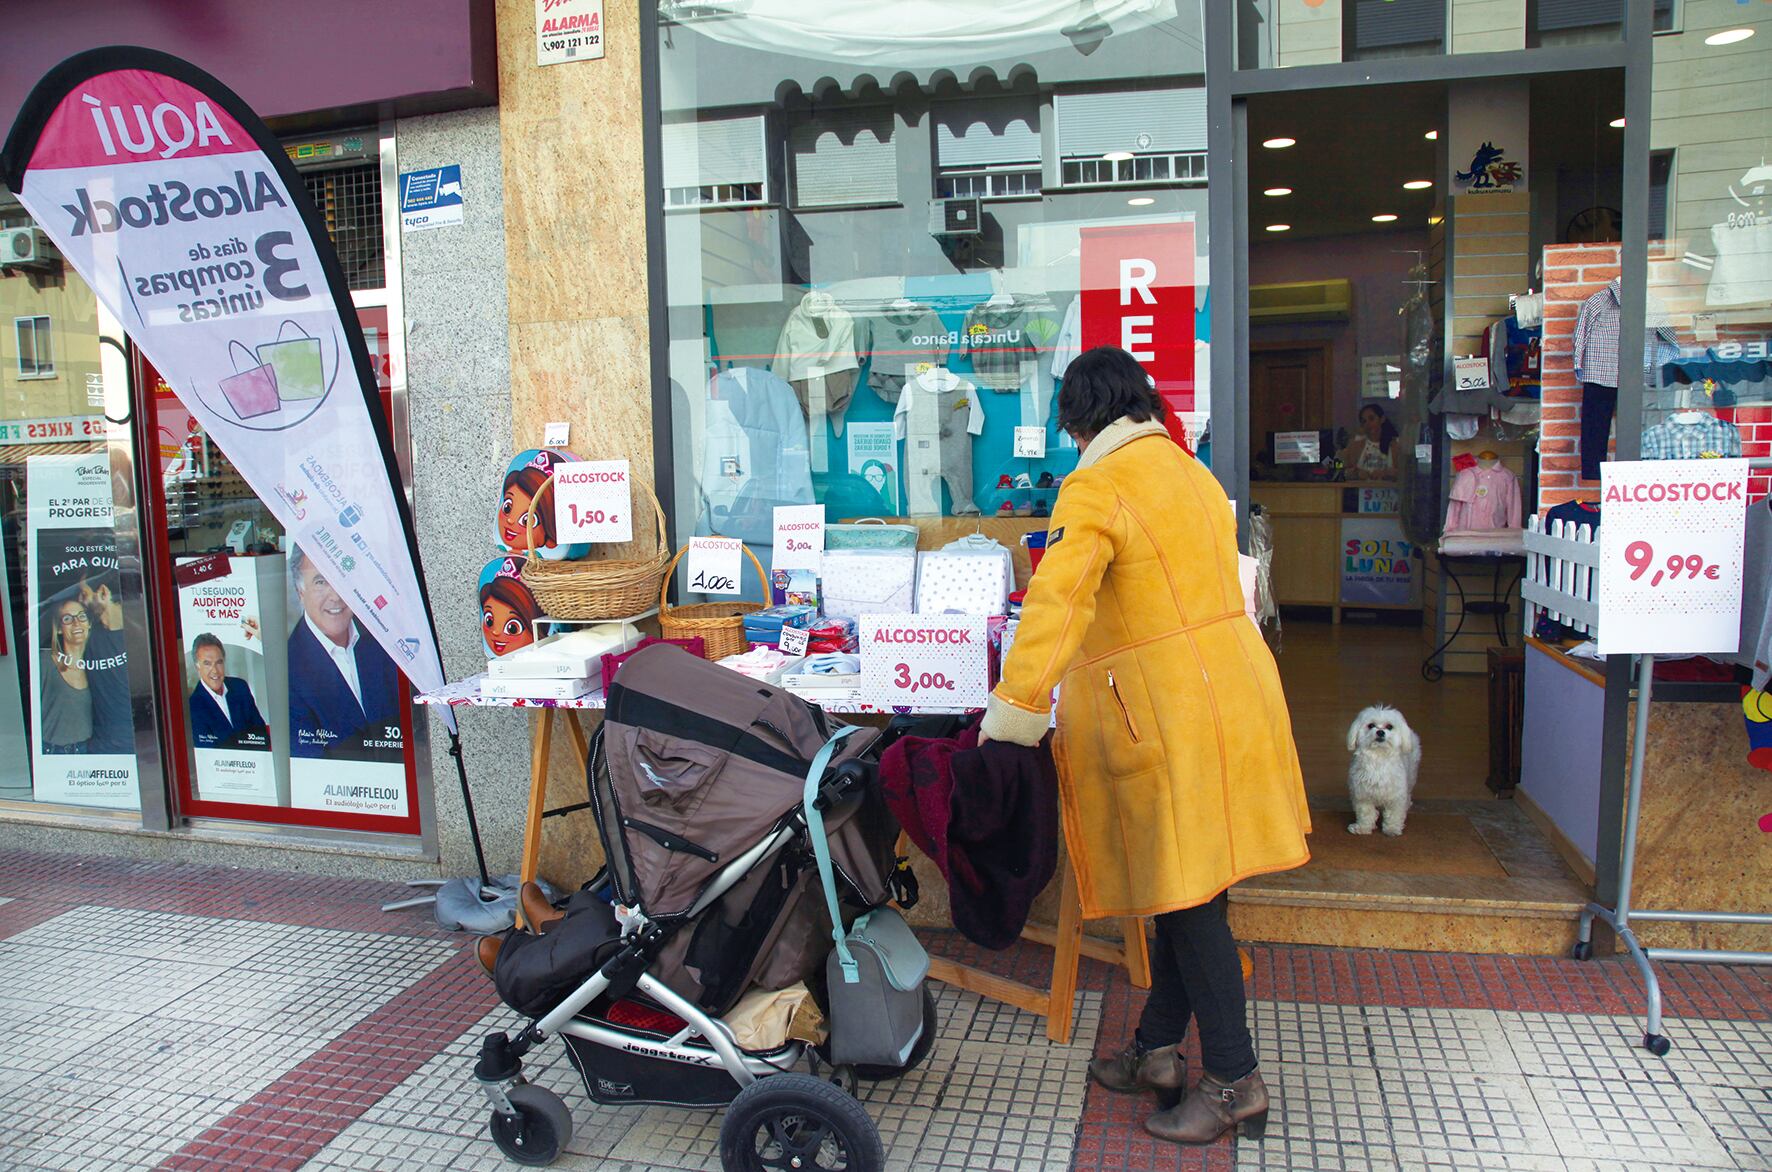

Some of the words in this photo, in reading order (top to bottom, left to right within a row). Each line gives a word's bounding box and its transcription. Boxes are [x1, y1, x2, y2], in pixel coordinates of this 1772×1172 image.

[541, 12, 599, 33] ALARMA
[550, 40, 565, 50] 902
[567, 37, 581, 48] 121
[584, 35, 600, 45] 122
[405, 216, 429, 227] tyco
[558, 472, 625, 484] ALCOSTOCK
[1605, 482, 1742, 503] ALCOSTOCK
[73, 498, 90, 506] PAR
[49, 507, 114, 518] PROGRESI
[568, 504, 604, 528] 1,50
[609, 514, 618, 523] €
[778, 522, 820, 531] ALCOSTOCK
[692, 540, 741, 550] ALCOSTOCK
[786, 538, 812, 552] 3,00€
[1345, 539, 1393, 557] SOL
[1396, 541, 1412, 557] Y
[52, 557, 88, 576] PARA
[1346, 556, 1410, 574] LUNA
[1624, 541, 1720, 587] 9,99€
[191, 587, 201, 595] TU
[202, 587, 245, 595] SEGUNDO
[206, 609, 216, 618] 1€
[218, 607, 240, 618] MÁS
[784, 627, 807, 637] ALCOSTOCK
[873, 628, 971, 645] ALCOSTOCK
[57, 651, 73, 666] TÚ
[893, 662, 955, 693] 3,00€
[384, 726, 401, 739] 30
[334, 799, 364, 808] audiólogo
[364, 800, 378, 809] loco
